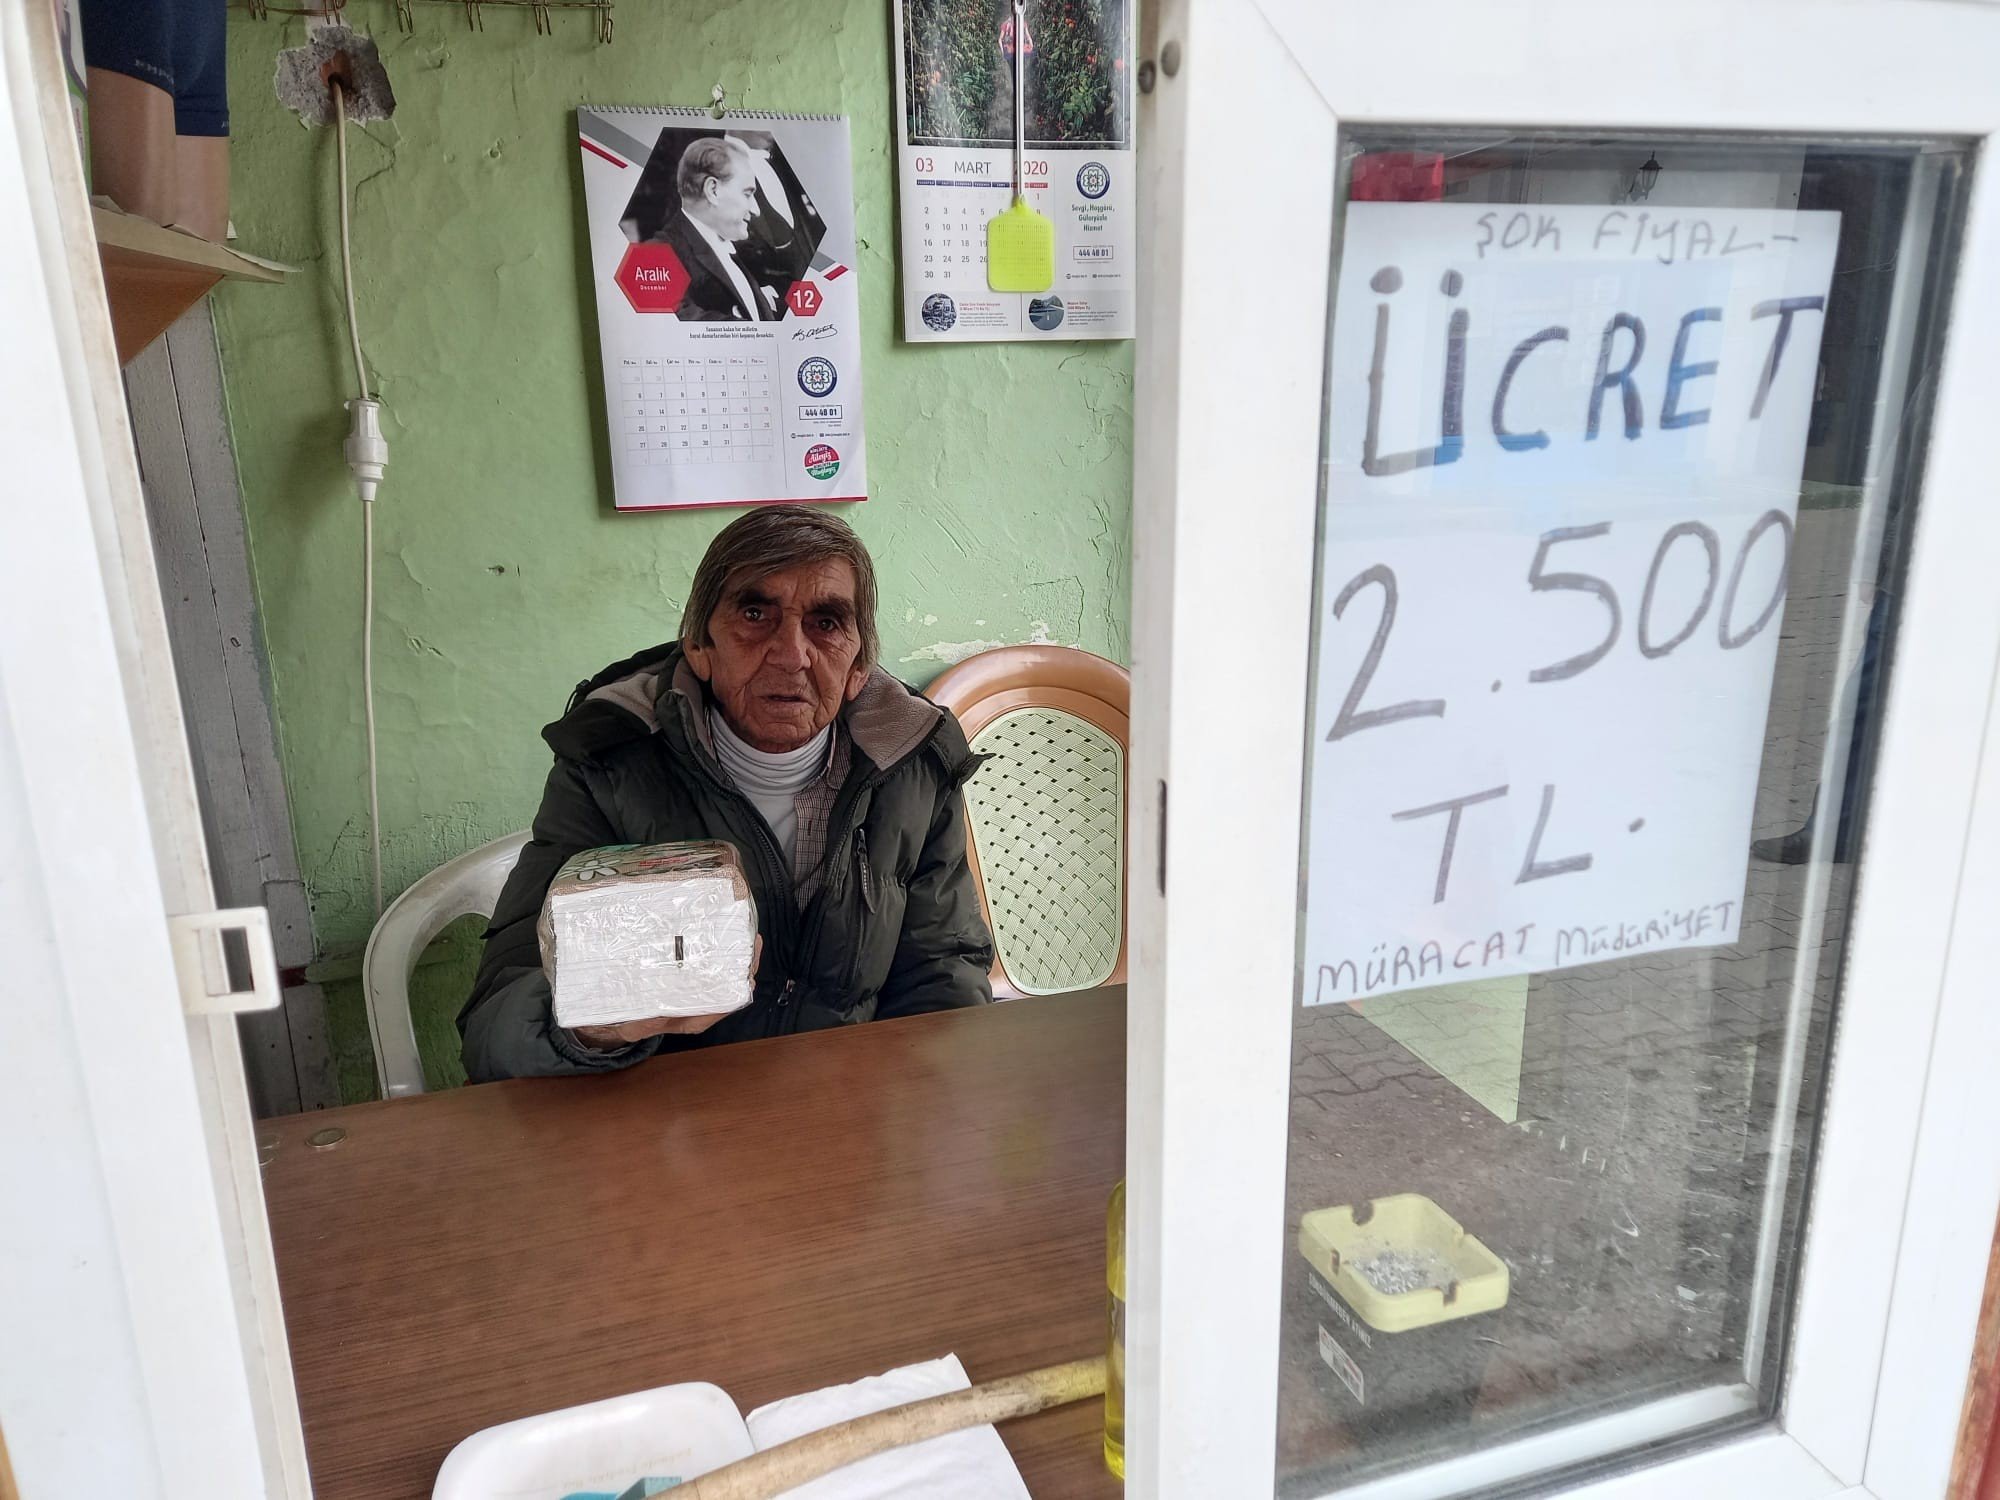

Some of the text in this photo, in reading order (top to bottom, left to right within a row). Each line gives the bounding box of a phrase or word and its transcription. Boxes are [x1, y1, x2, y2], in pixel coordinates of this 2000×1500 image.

[915, 157, 934, 172] 03
[954, 161, 992, 174] MART
[924, 206, 929, 214] 2
[962, 207, 966, 215] 4
[943, 255, 952, 263] 24
[635, 266, 671, 282] Aralık
[792, 290, 815, 309] 12
[1361, 265, 1826, 477] ÜCRET
[804, 407, 818, 417] 444
[1315, 922, 1536, 1003] MÜRACAT
